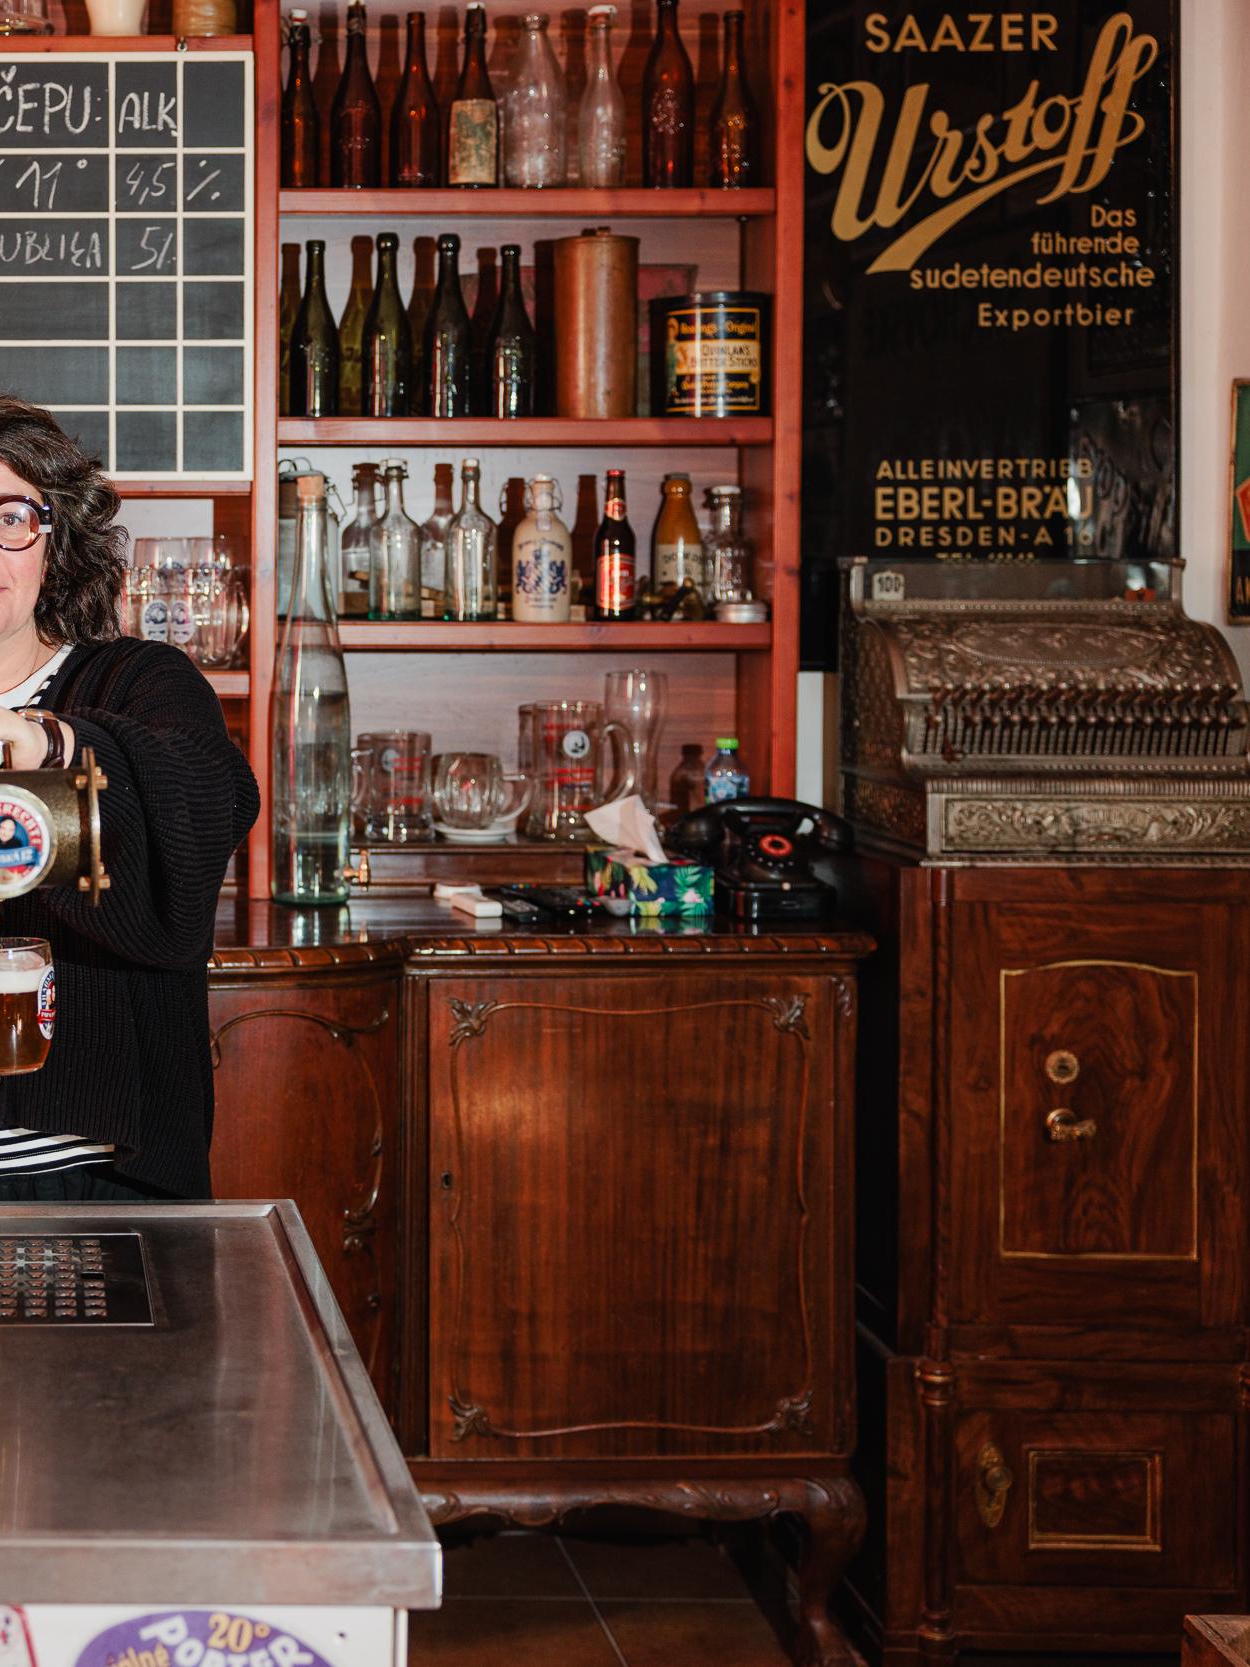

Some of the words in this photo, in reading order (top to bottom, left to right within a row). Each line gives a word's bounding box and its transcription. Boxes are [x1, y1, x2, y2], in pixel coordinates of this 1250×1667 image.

[864, 12, 1059, 52] SAAZER
[805, 12, 1159, 242] Urstoff
[125, 162, 175, 205] 4,5
[1091, 204, 1137, 228] Das
[1031, 231, 1140, 255] führende
[910, 262, 1155, 289] sudetendeutsche
[977, 303, 1135, 331] Exportbier
[876, 459, 1093, 480] ALLEINVERTRIEB
[875, 526, 1053, 547] DRESDEN-A
[207, 1611, 271, 1654] 20°
